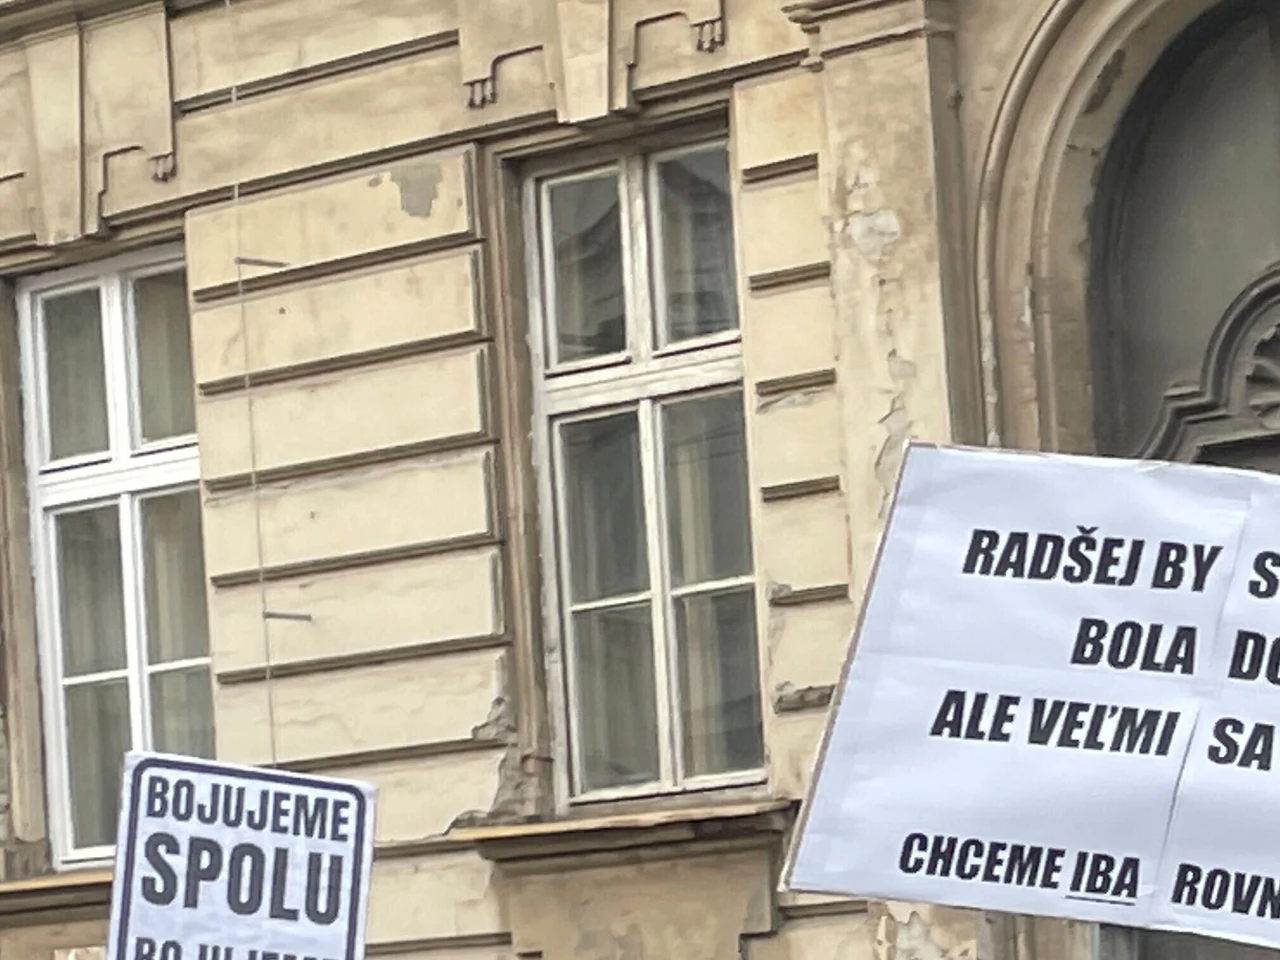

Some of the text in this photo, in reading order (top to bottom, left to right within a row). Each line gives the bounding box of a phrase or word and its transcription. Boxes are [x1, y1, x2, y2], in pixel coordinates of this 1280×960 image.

[962, 525, 1145, 588] RADŠEJ
[1151, 541, 1224, 593] BY
[1070, 617, 1197, 675] BOLA
[930, 689, 1021, 742] ALE
[1028, 698, 1182, 757] VEĽMI
[1208, 718, 1275, 771] SA
[146, 775, 350, 842] BOJUJEME
[141, 832, 344, 925] SPOLU
[899, 832, 1066, 890] CHCEME
[1068, 851, 1140, 899] IBA
